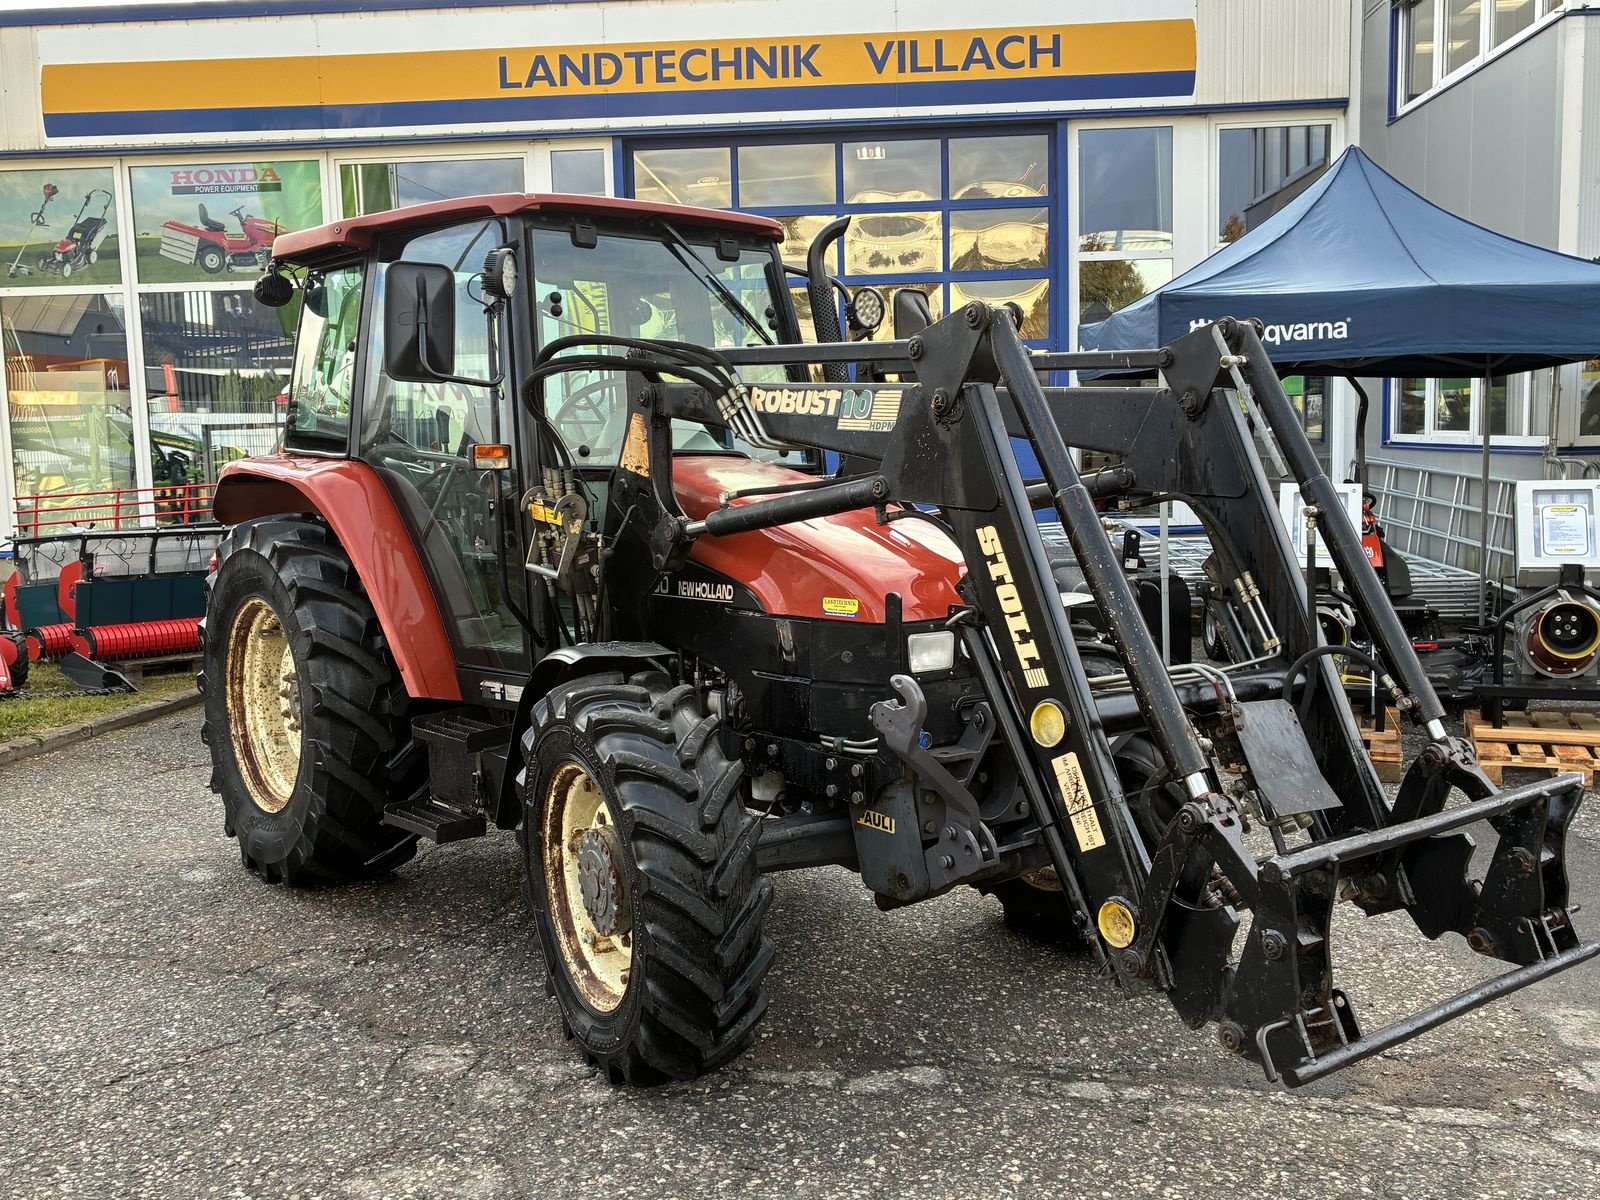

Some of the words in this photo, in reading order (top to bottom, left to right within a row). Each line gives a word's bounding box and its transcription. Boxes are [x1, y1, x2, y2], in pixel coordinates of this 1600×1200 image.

[498, 43, 822, 89] LANDTECHNIK
[863, 34, 1061, 75] VILLACH
[170, 168, 281, 184] HONDA
[194, 185, 220, 193] POWER
[220, 184, 258, 193] EQUIPMENT
[1261, 321, 1348, 345] qvarna
[751, 387, 842, 416] ROBUST
[842, 389, 873, 420] 10
[868, 421, 896, 431] HDPM
[654, 576, 669, 594] 0
[678, 581, 695, 597] NEW
[695, 582, 734, 600] HOLLAND
[975, 525, 1044, 671] STOLL
[858, 811, 893, 832] AULI
